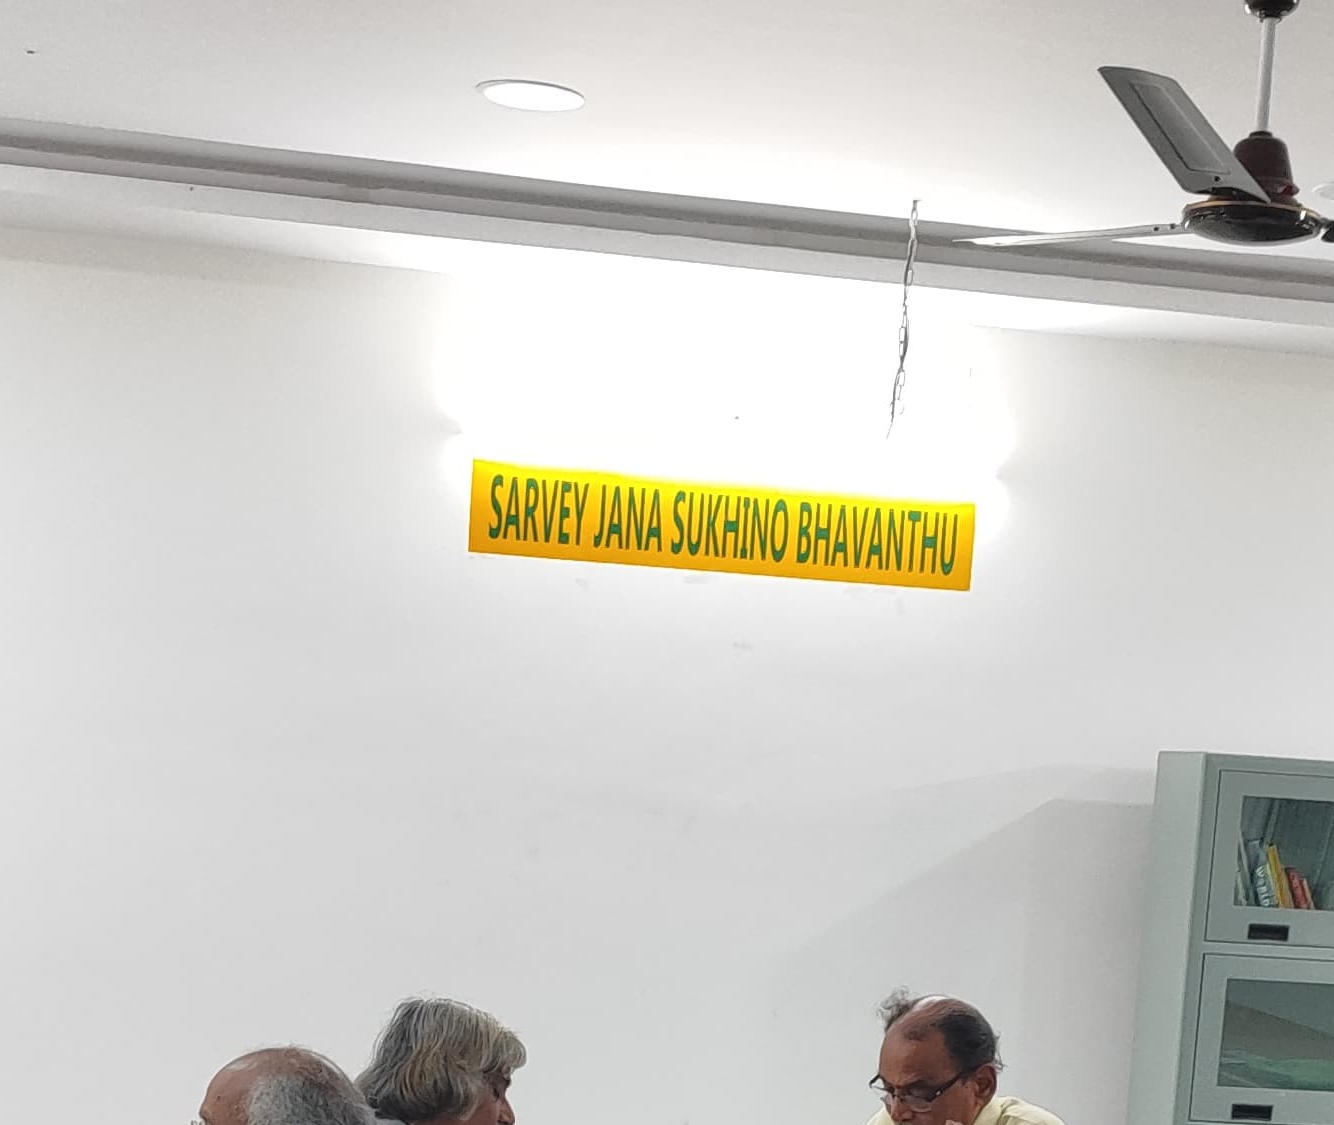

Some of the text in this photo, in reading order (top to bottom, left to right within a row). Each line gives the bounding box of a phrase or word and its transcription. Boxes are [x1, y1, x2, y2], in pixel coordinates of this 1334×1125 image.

[488, 474, 958, 576] SARVEY JANA SUKHINO BHAVANTHU
